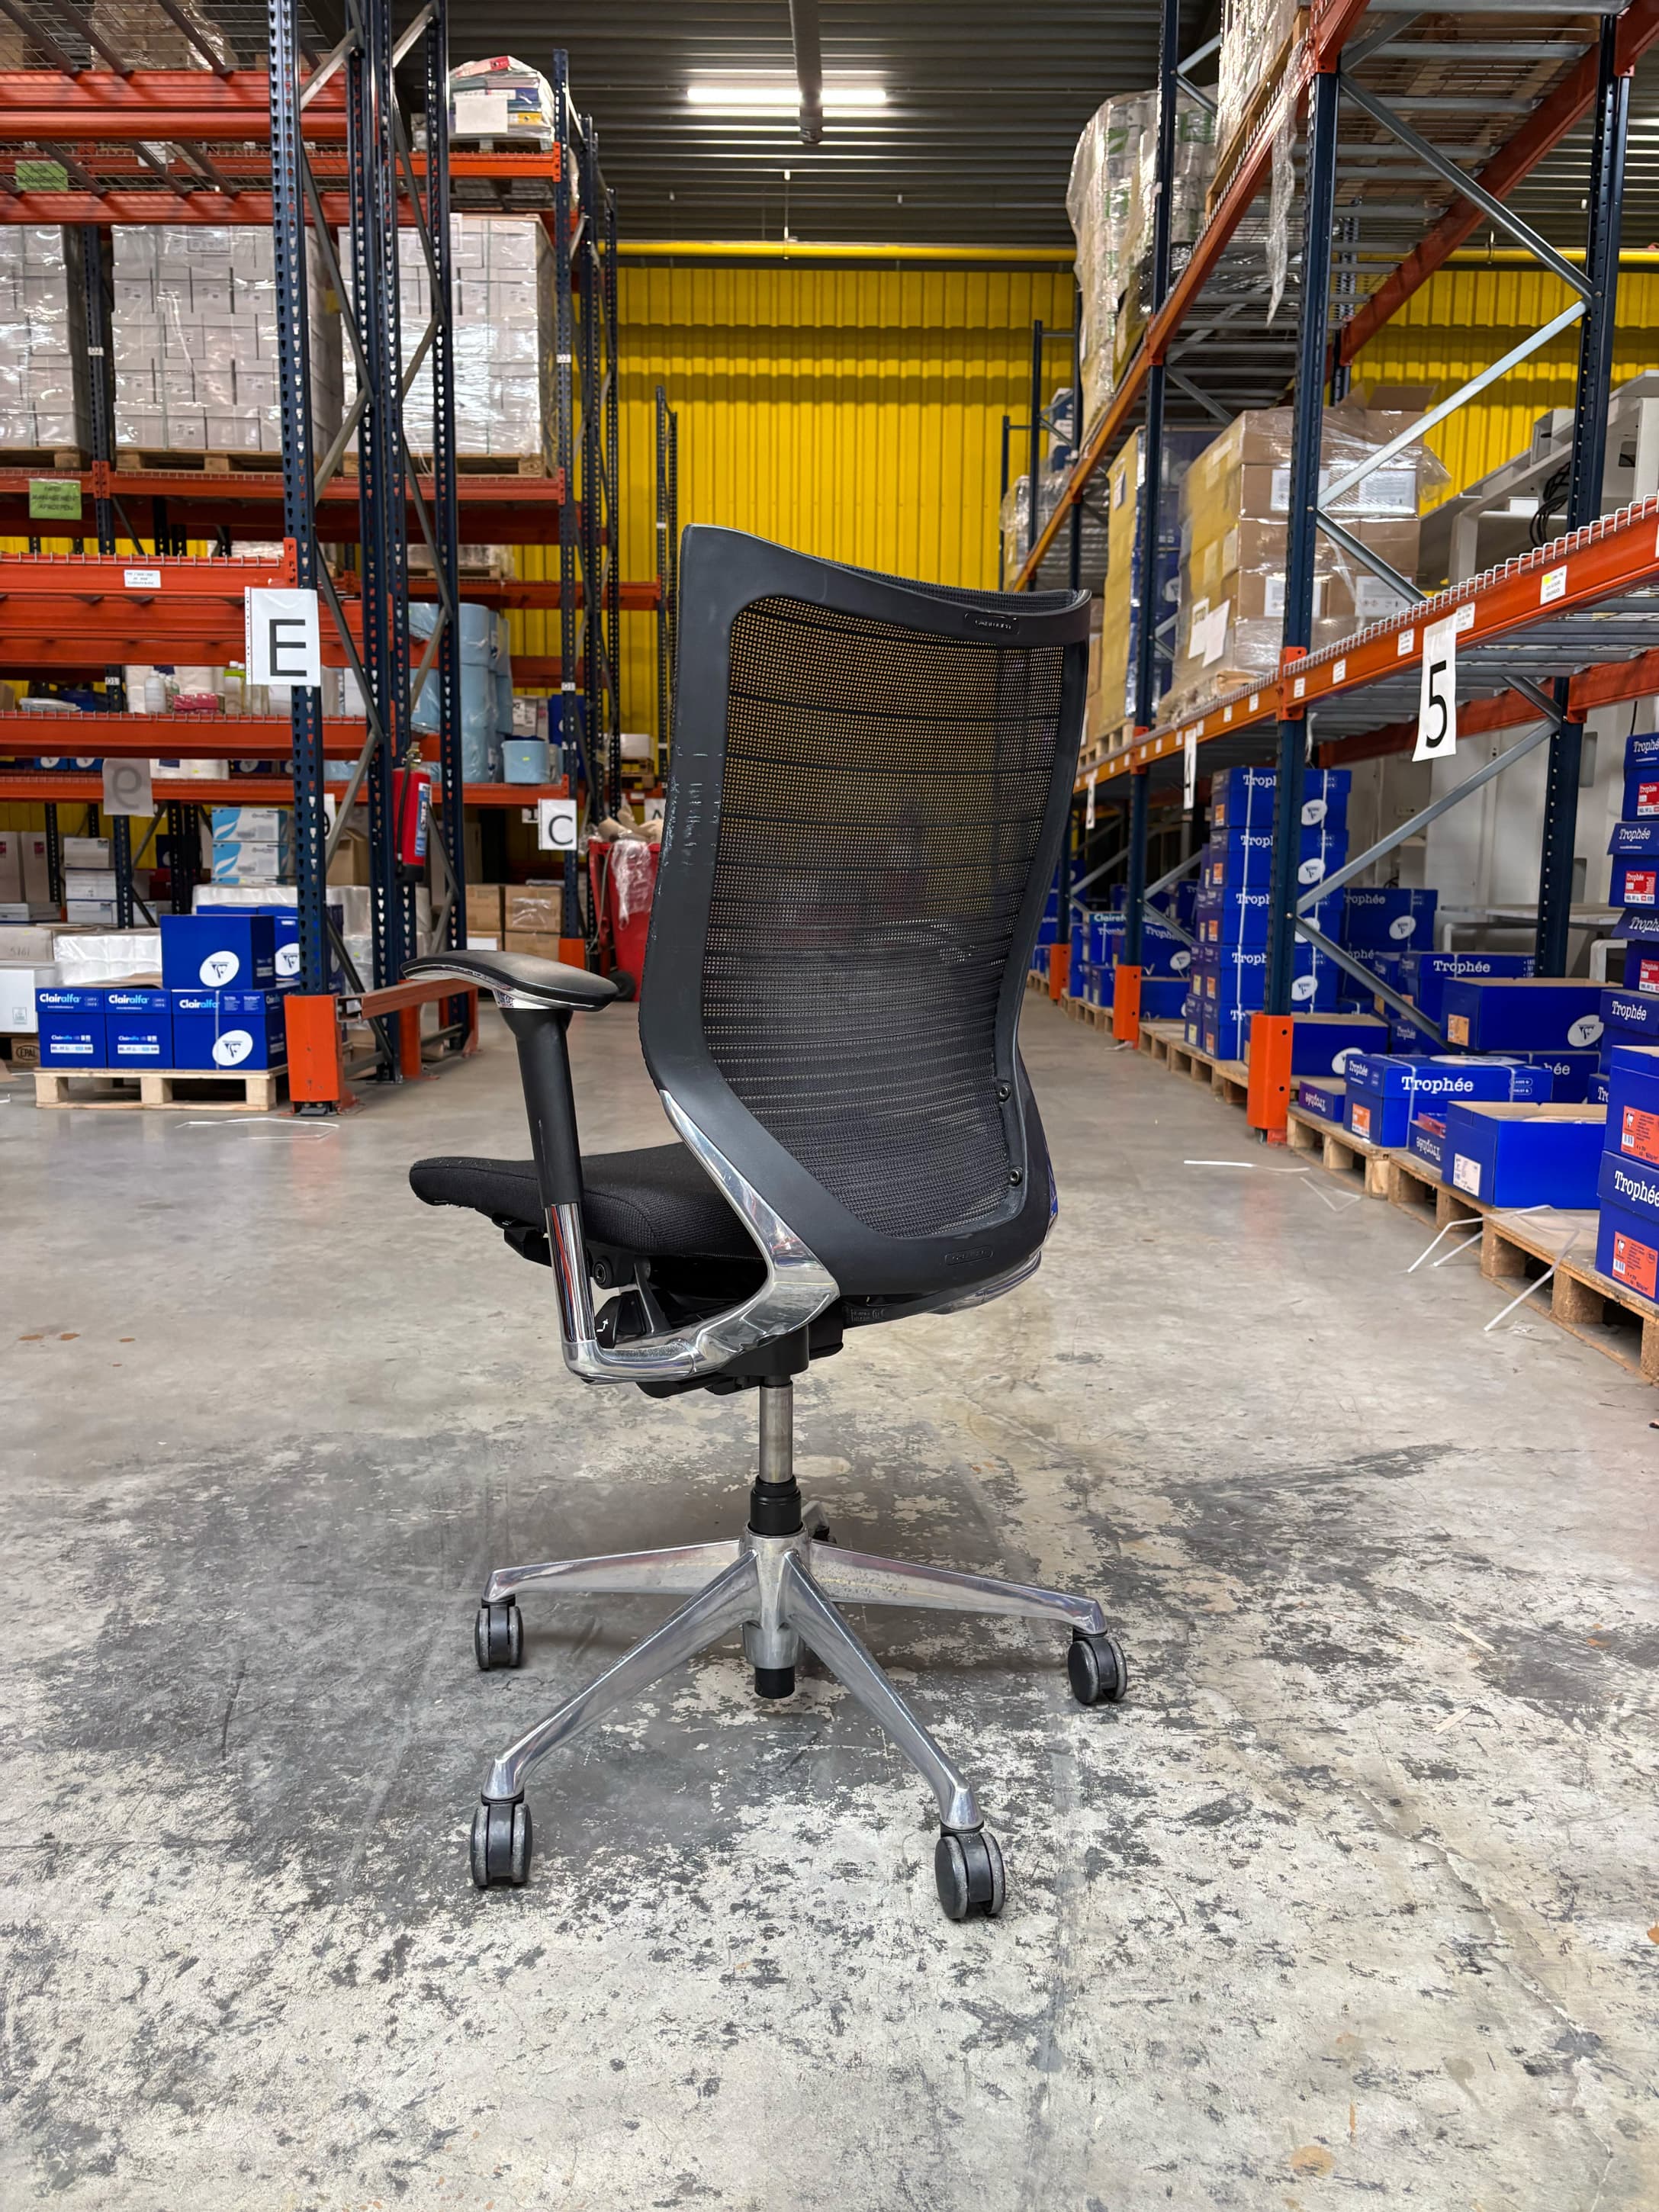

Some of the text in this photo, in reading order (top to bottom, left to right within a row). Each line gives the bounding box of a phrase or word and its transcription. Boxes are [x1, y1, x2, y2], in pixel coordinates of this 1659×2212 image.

[269, 619, 307, 677] E
[1426, 660, 1448, 748] 5
[548, 815, 573, 845] C
[1618, 828, 1651, 842] Trophée
[1343, 893, 1386, 906] rophée
[1433, 960, 1490, 974] Trophée
[40, 993, 82, 1003] Clairalfa
[108, 994, 150, 1005] Clairalfa
[1612, 1000, 1647, 1021] Trophée
[1349, 1059, 1369, 1077] Trophée
[1401, 1076, 1474, 1095] Trophée
[1304, 1092, 1326, 1113] Trophée
[1415, 1136, 1442, 1162] Trophée
[1613, 1170, 1659, 1208] Trophée
